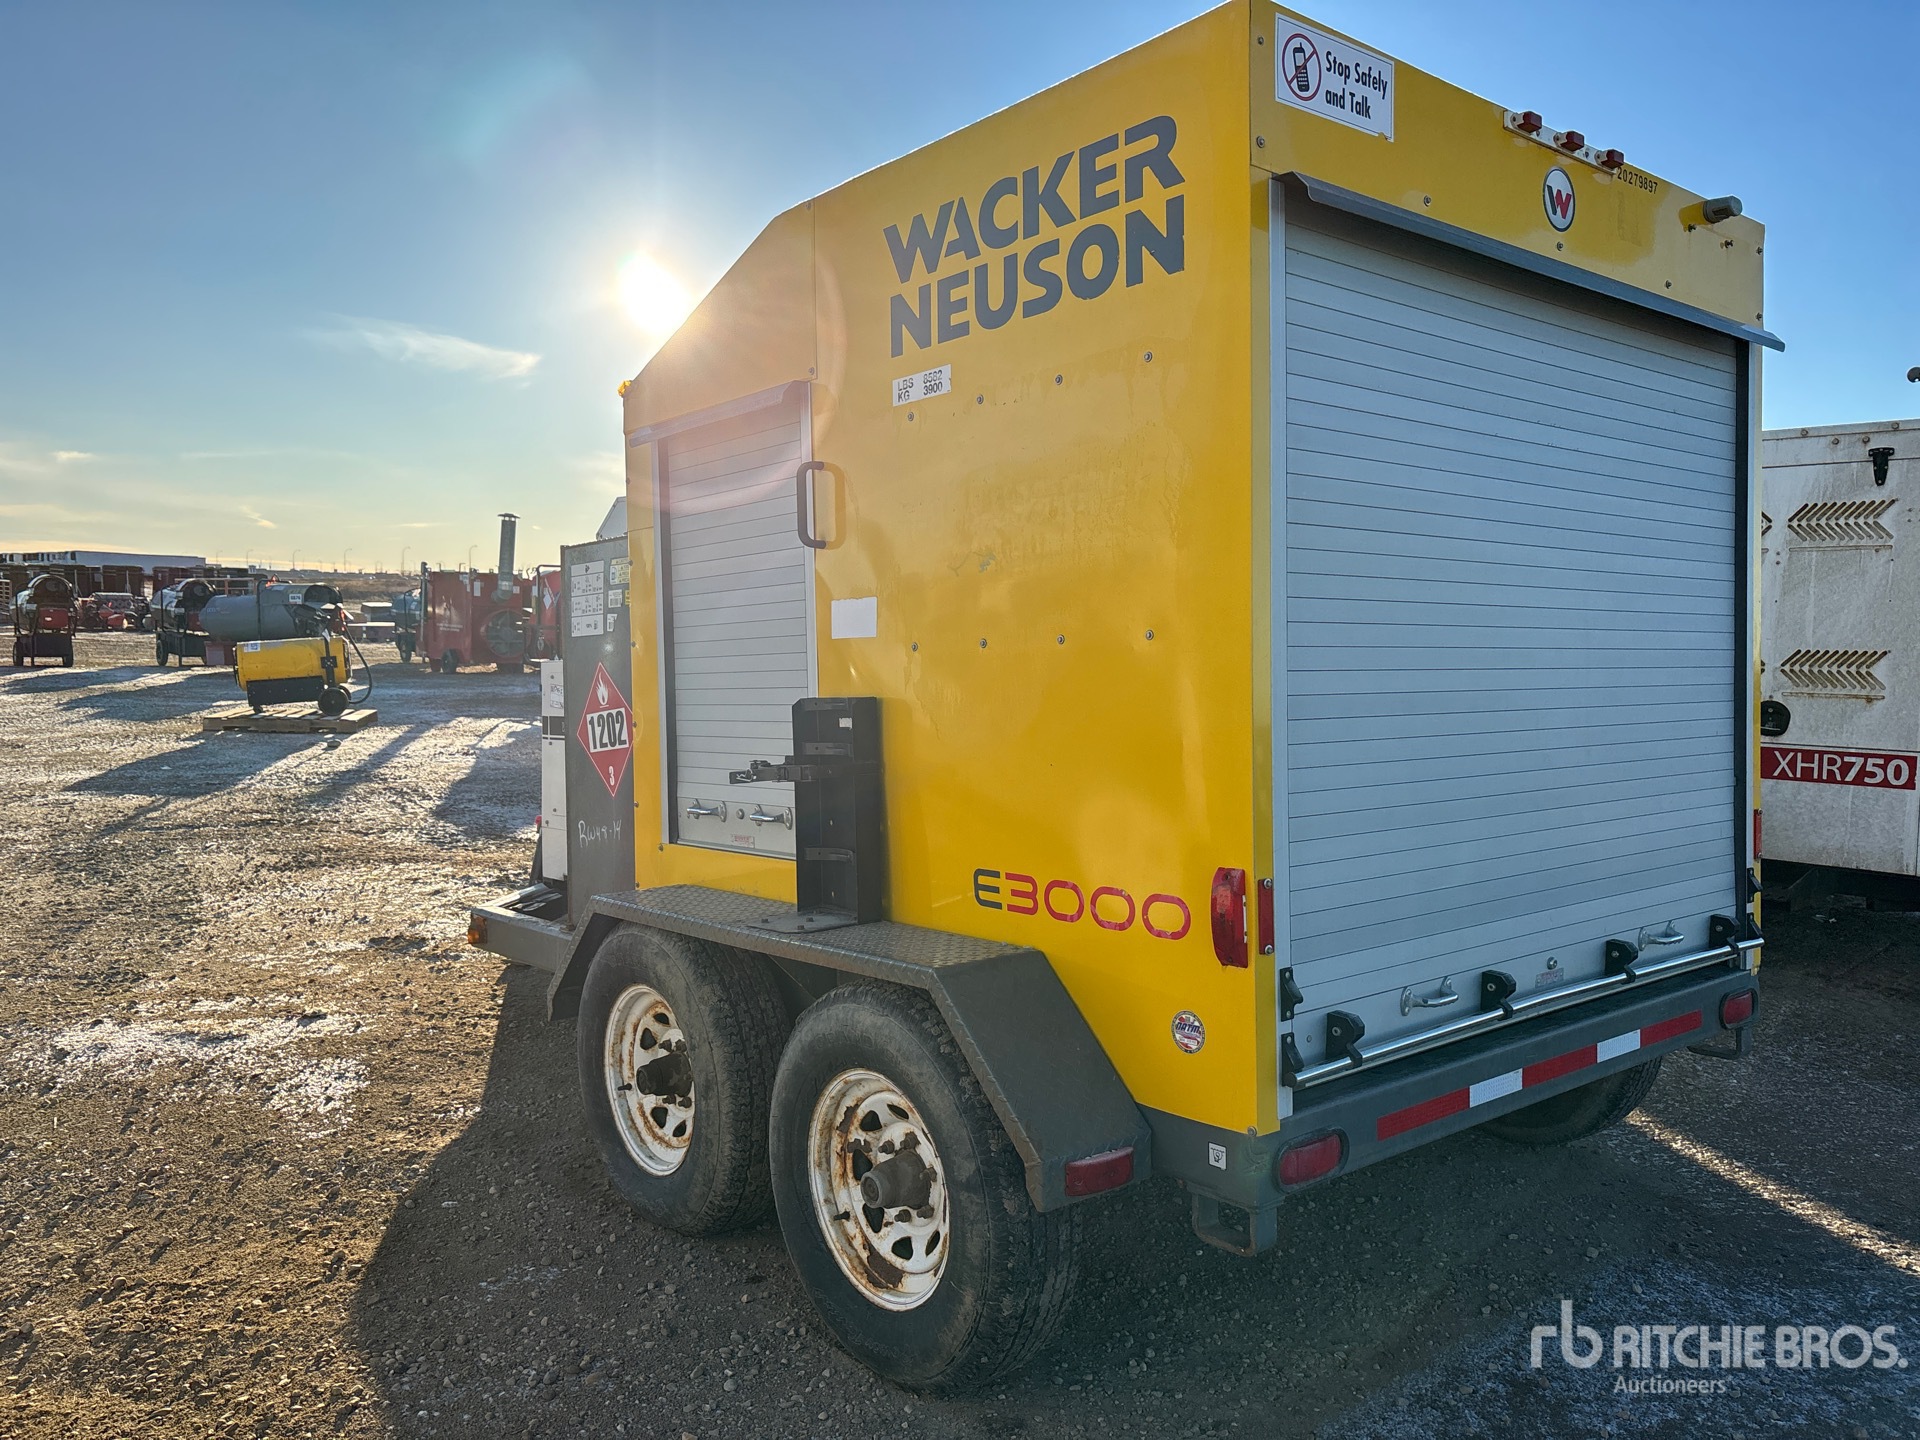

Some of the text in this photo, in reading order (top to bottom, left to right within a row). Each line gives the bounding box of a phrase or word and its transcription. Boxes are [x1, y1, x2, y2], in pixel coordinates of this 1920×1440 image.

[1325, 51, 1388, 100] Stop Safely
[1325, 88, 1372, 120] and Talk
[1617, 166, 1658, 194] 20279897
[883, 115, 1186, 284] WACKER
[890, 194, 1185, 359] NEUSON
[897, 369, 943, 391] LBS 8582
[897, 381, 943, 402] KG 3900
[589, 710, 627, 750] 1202
[608, 765, 615, 786] 3
[1772, 751, 1910, 786] XHR750
[973, 868, 1191, 941] E3000
